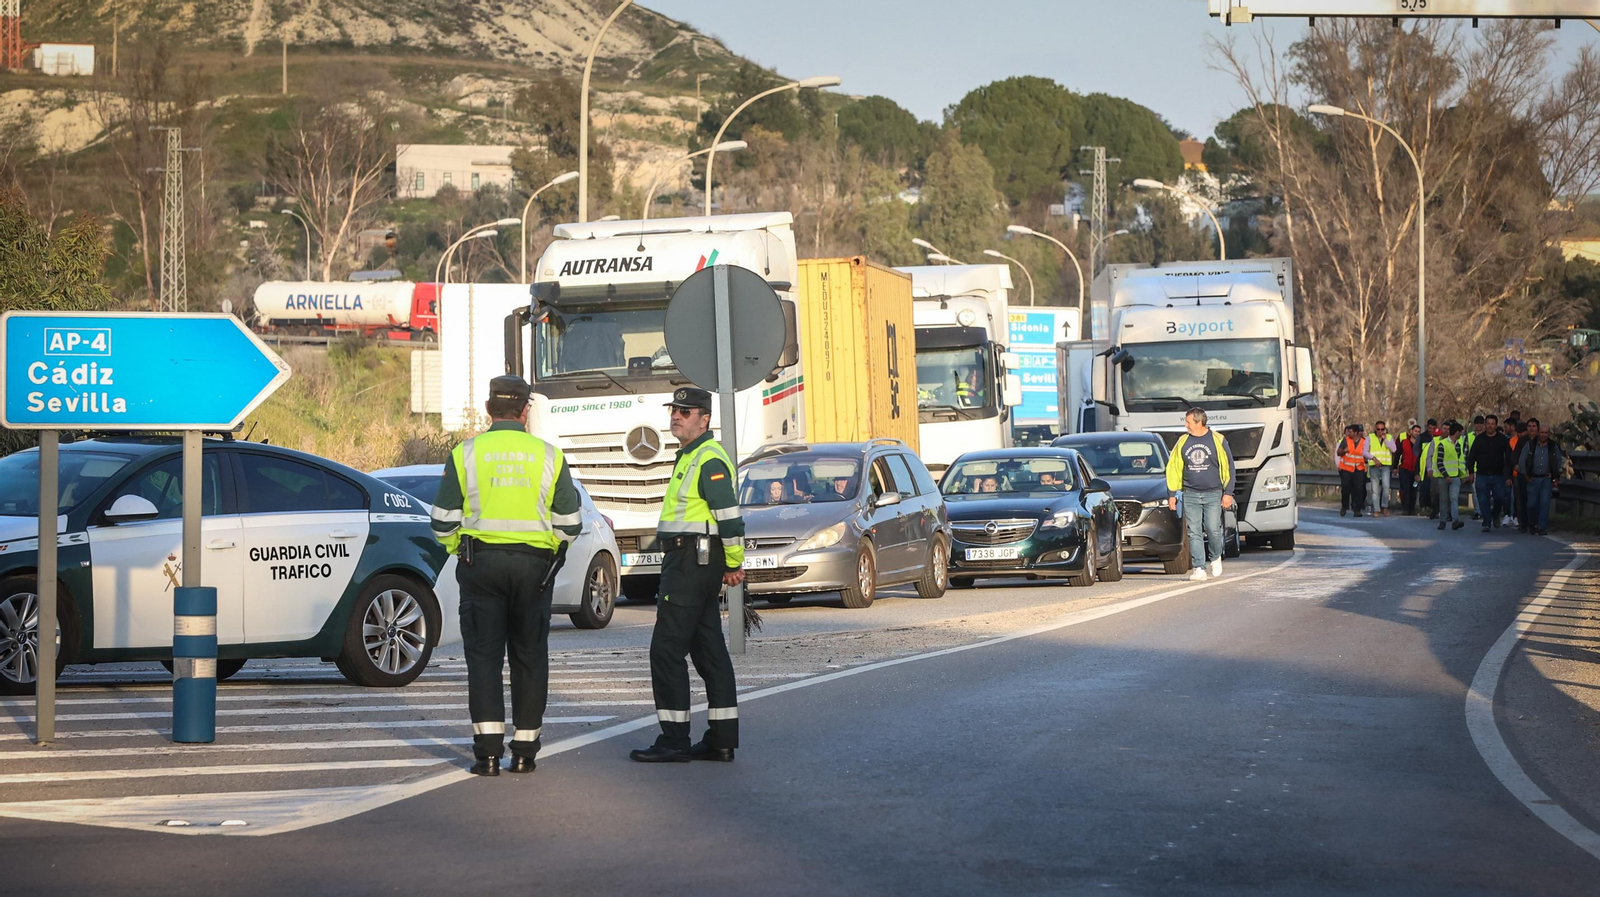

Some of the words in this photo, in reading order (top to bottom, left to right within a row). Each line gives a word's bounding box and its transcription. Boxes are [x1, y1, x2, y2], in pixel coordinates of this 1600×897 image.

[559, 256, 653, 277] AUTRANSA
[285, 294, 363, 310] ARNIELLA
[1011, 323, 1049, 333] Sidonia
[1166, 320, 1234, 336] Bayport
[49, 332, 107, 351] AP-4
[27, 361, 114, 385] Cádiz
[1022, 372, 1057, 384] Sevill
[27, 391, 127, 413] Sevilla
[550, 404, 579, 414] Group
[582, 402, 606, 411] since
[609, 400, 632, 409] 1980
[484, 451, 536, 463] GUARDIA
[496, 464, 525, 475] CIVIL
[390, 493, 412, 508] 062
[250, 545, 311, 562] GUARDIA
[315, 543, 350, 558] CIVIL
[630, 555, 652, 564] 3778
[971, 549, 995, 558] 7338
[998, 548, 1015, 558] JGP
[756, 557, 775, 567] BWN
[270, 563, 332, 580] TRAFICO
